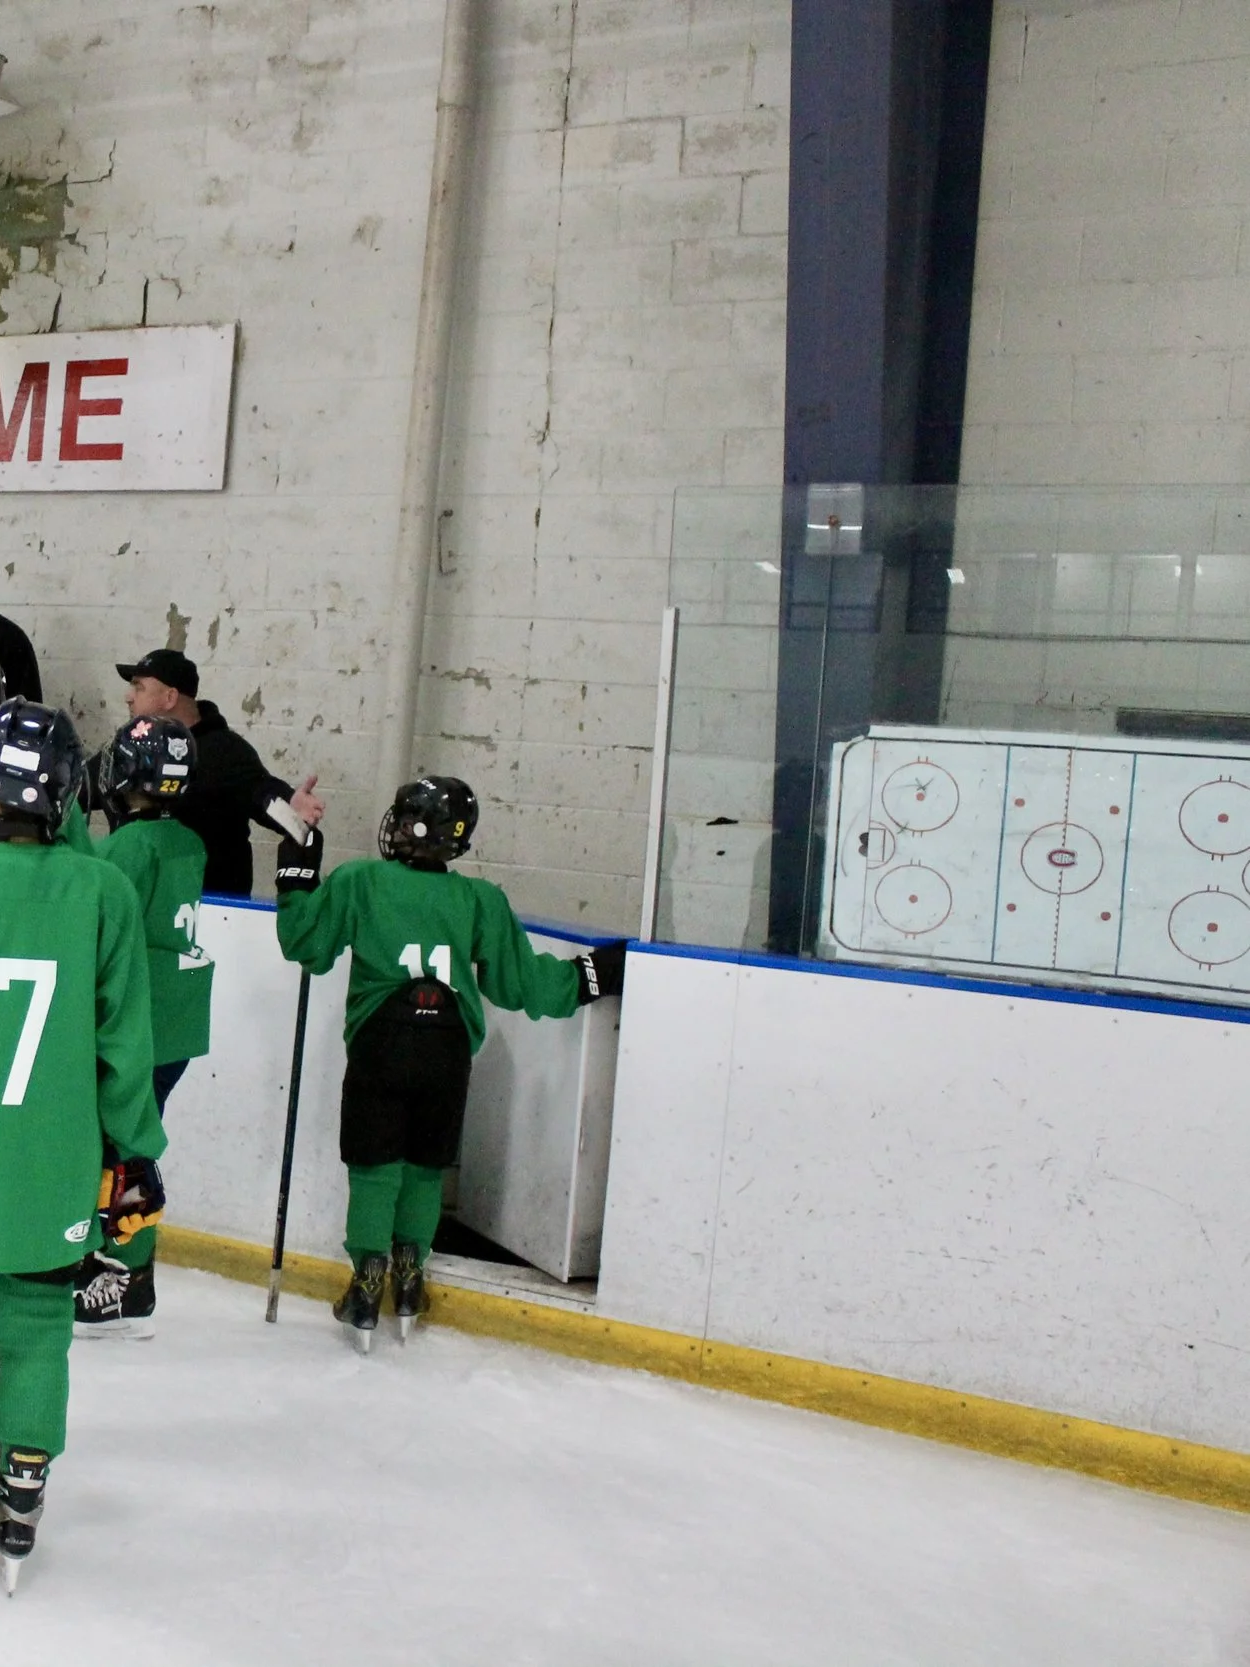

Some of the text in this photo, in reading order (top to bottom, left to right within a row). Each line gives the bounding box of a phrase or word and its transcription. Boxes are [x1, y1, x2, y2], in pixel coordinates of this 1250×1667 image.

[159, 779, 181, 793] 23
[453, 820, 466, 837] 9
[397, 943, 457, 992] 11
